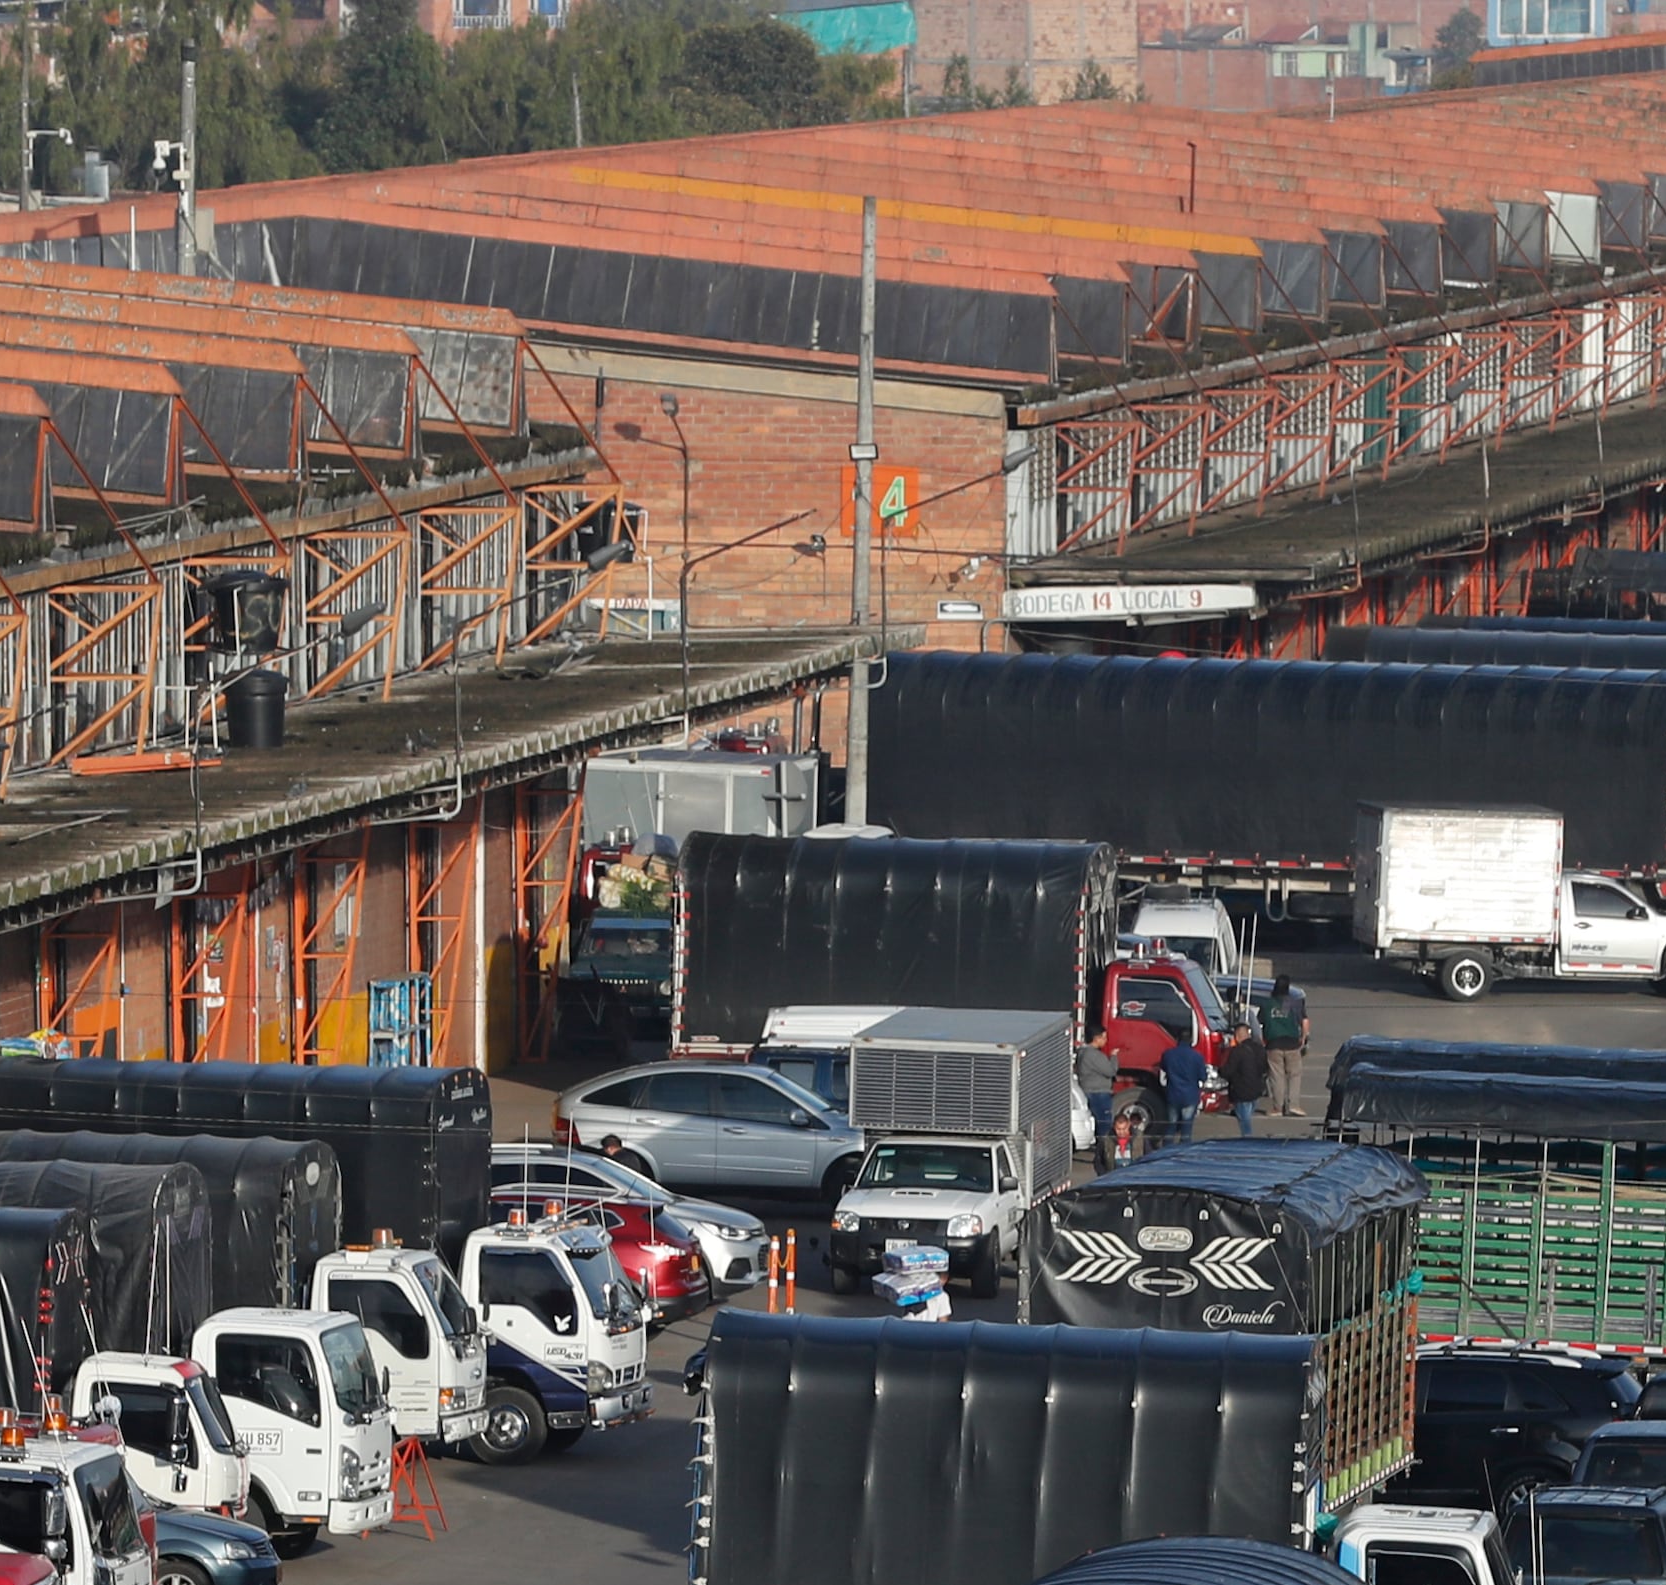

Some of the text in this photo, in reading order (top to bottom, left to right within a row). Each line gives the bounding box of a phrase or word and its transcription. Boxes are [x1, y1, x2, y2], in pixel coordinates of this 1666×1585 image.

[1011, 589, 1203, 616] BODEGA 14 LOCAL 9
[1203, 1301, 1286, 1330] Daniela
[257, 1433, 280, 1445] 857
